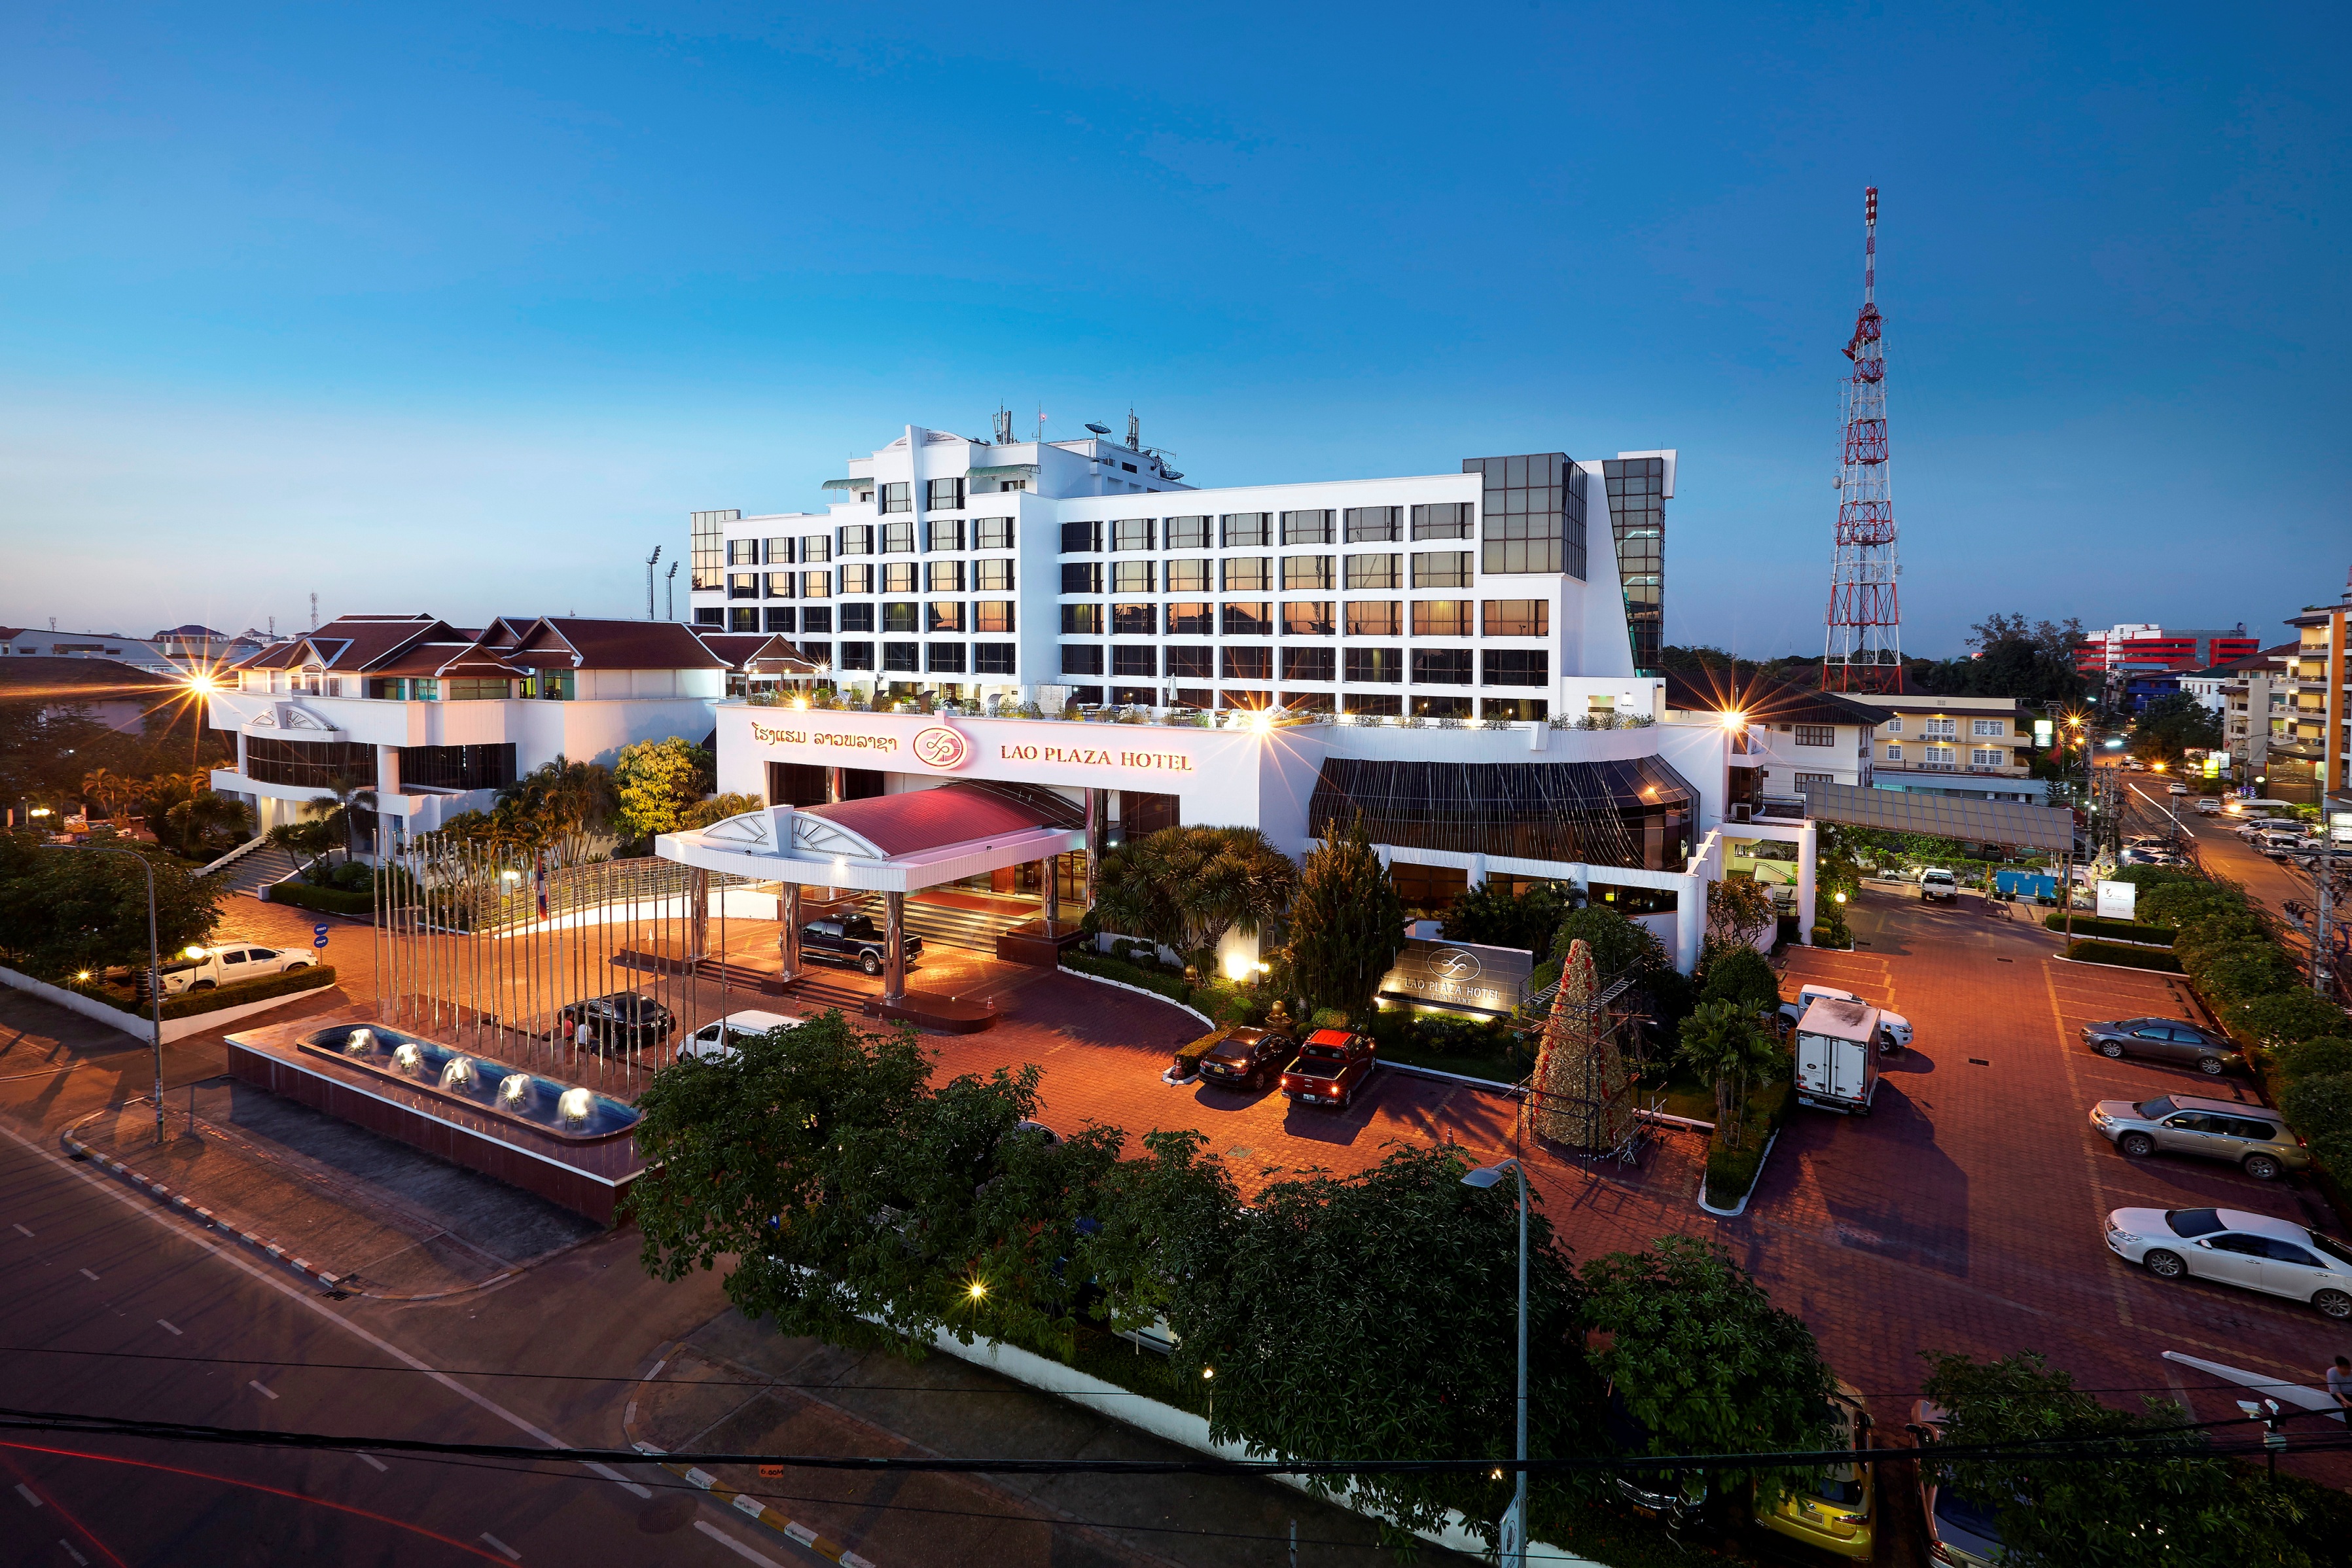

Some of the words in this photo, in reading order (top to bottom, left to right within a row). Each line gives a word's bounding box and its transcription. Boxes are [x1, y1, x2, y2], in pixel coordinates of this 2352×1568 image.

[1001, 745, 1038, 760] LAO
[1044, 747, 1113, 766] PLAZA
[1120, 751, 1193, 771] HOTEL
[1404, 976, 1425, 989] LAO
[1429, 980, 1463, 995] PLAZA
[1466, 986, 1501, 1001] HOTEL
[1430, 993, 1472, 1005] VIENTIANE
